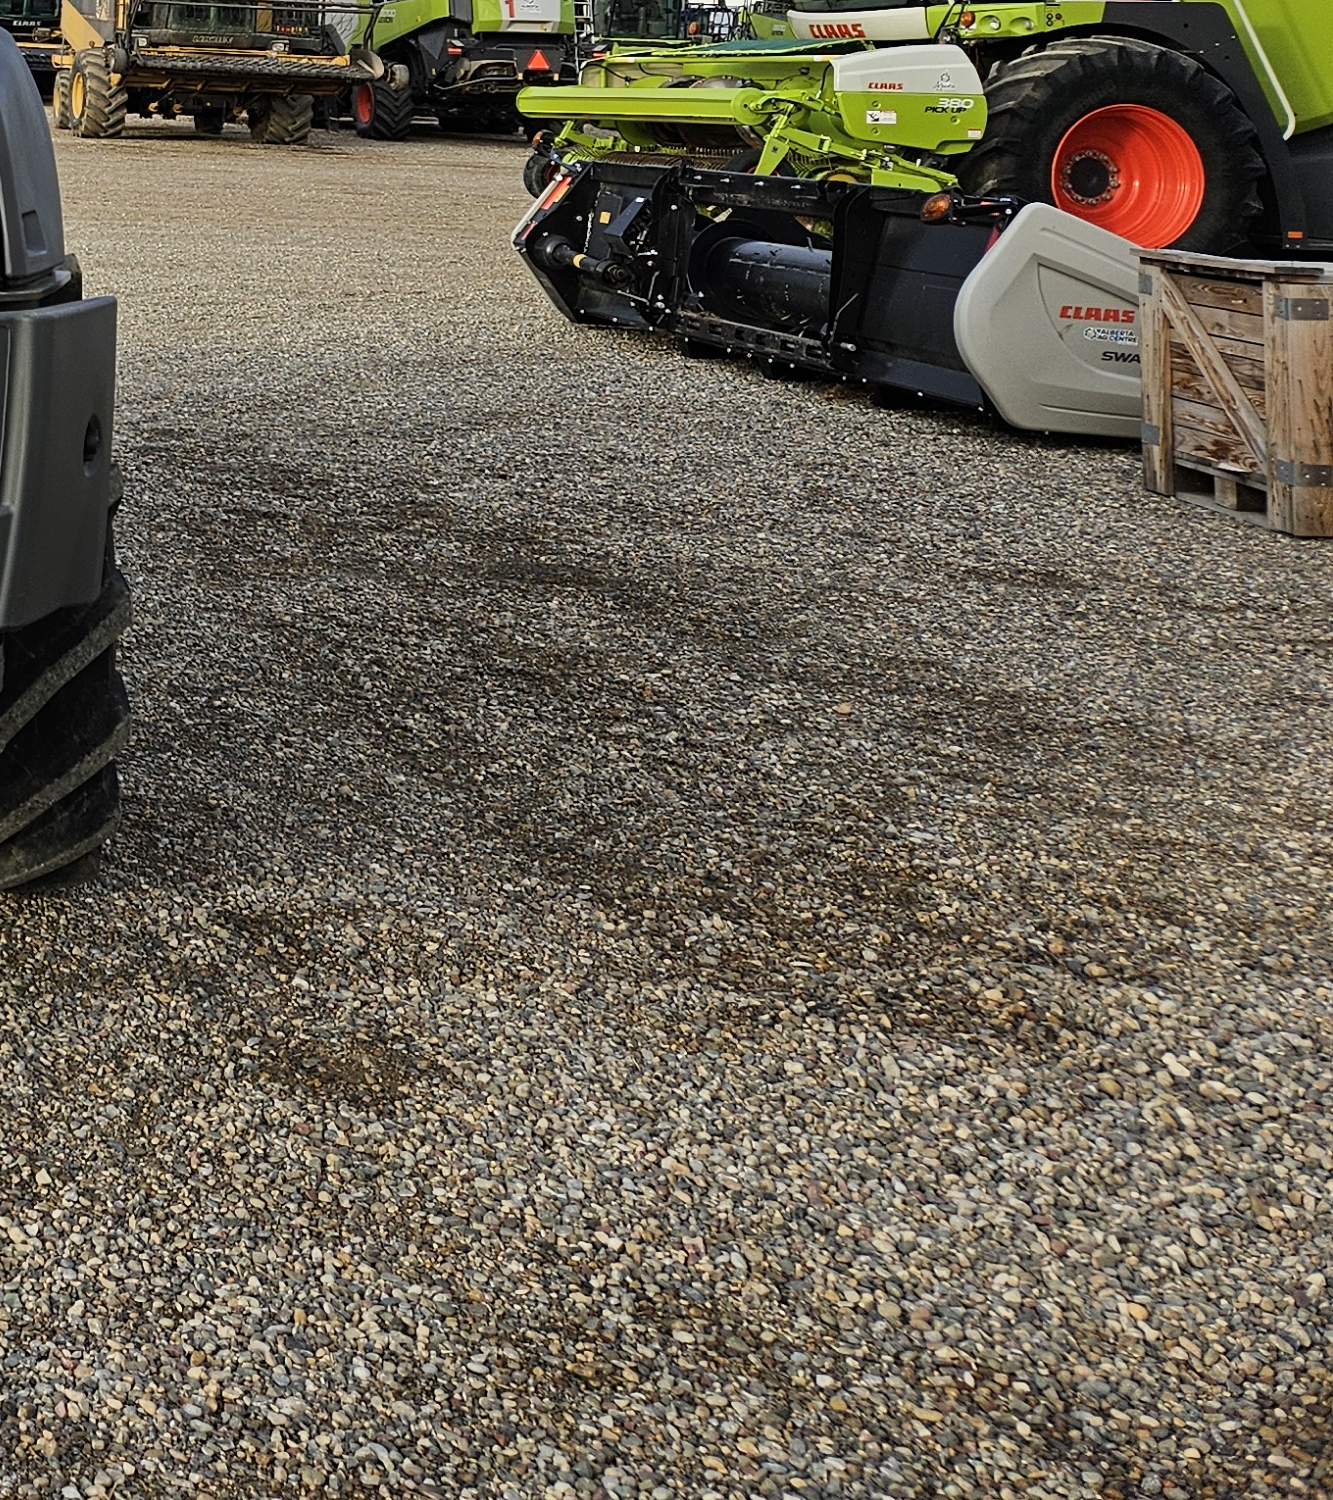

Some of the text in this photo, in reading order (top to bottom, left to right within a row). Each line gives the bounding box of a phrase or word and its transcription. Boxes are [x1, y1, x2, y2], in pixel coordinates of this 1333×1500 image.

[505, 0, 515, 18] 1
[808, 23, 866, 38] CLAAS
[868, 82, 903, 90] CLAAS
[937, 98, 974, 108] 380
[1059, 306, 1136, 324] CLAAS
[1109, 335, 1137, 343] CENTRE
